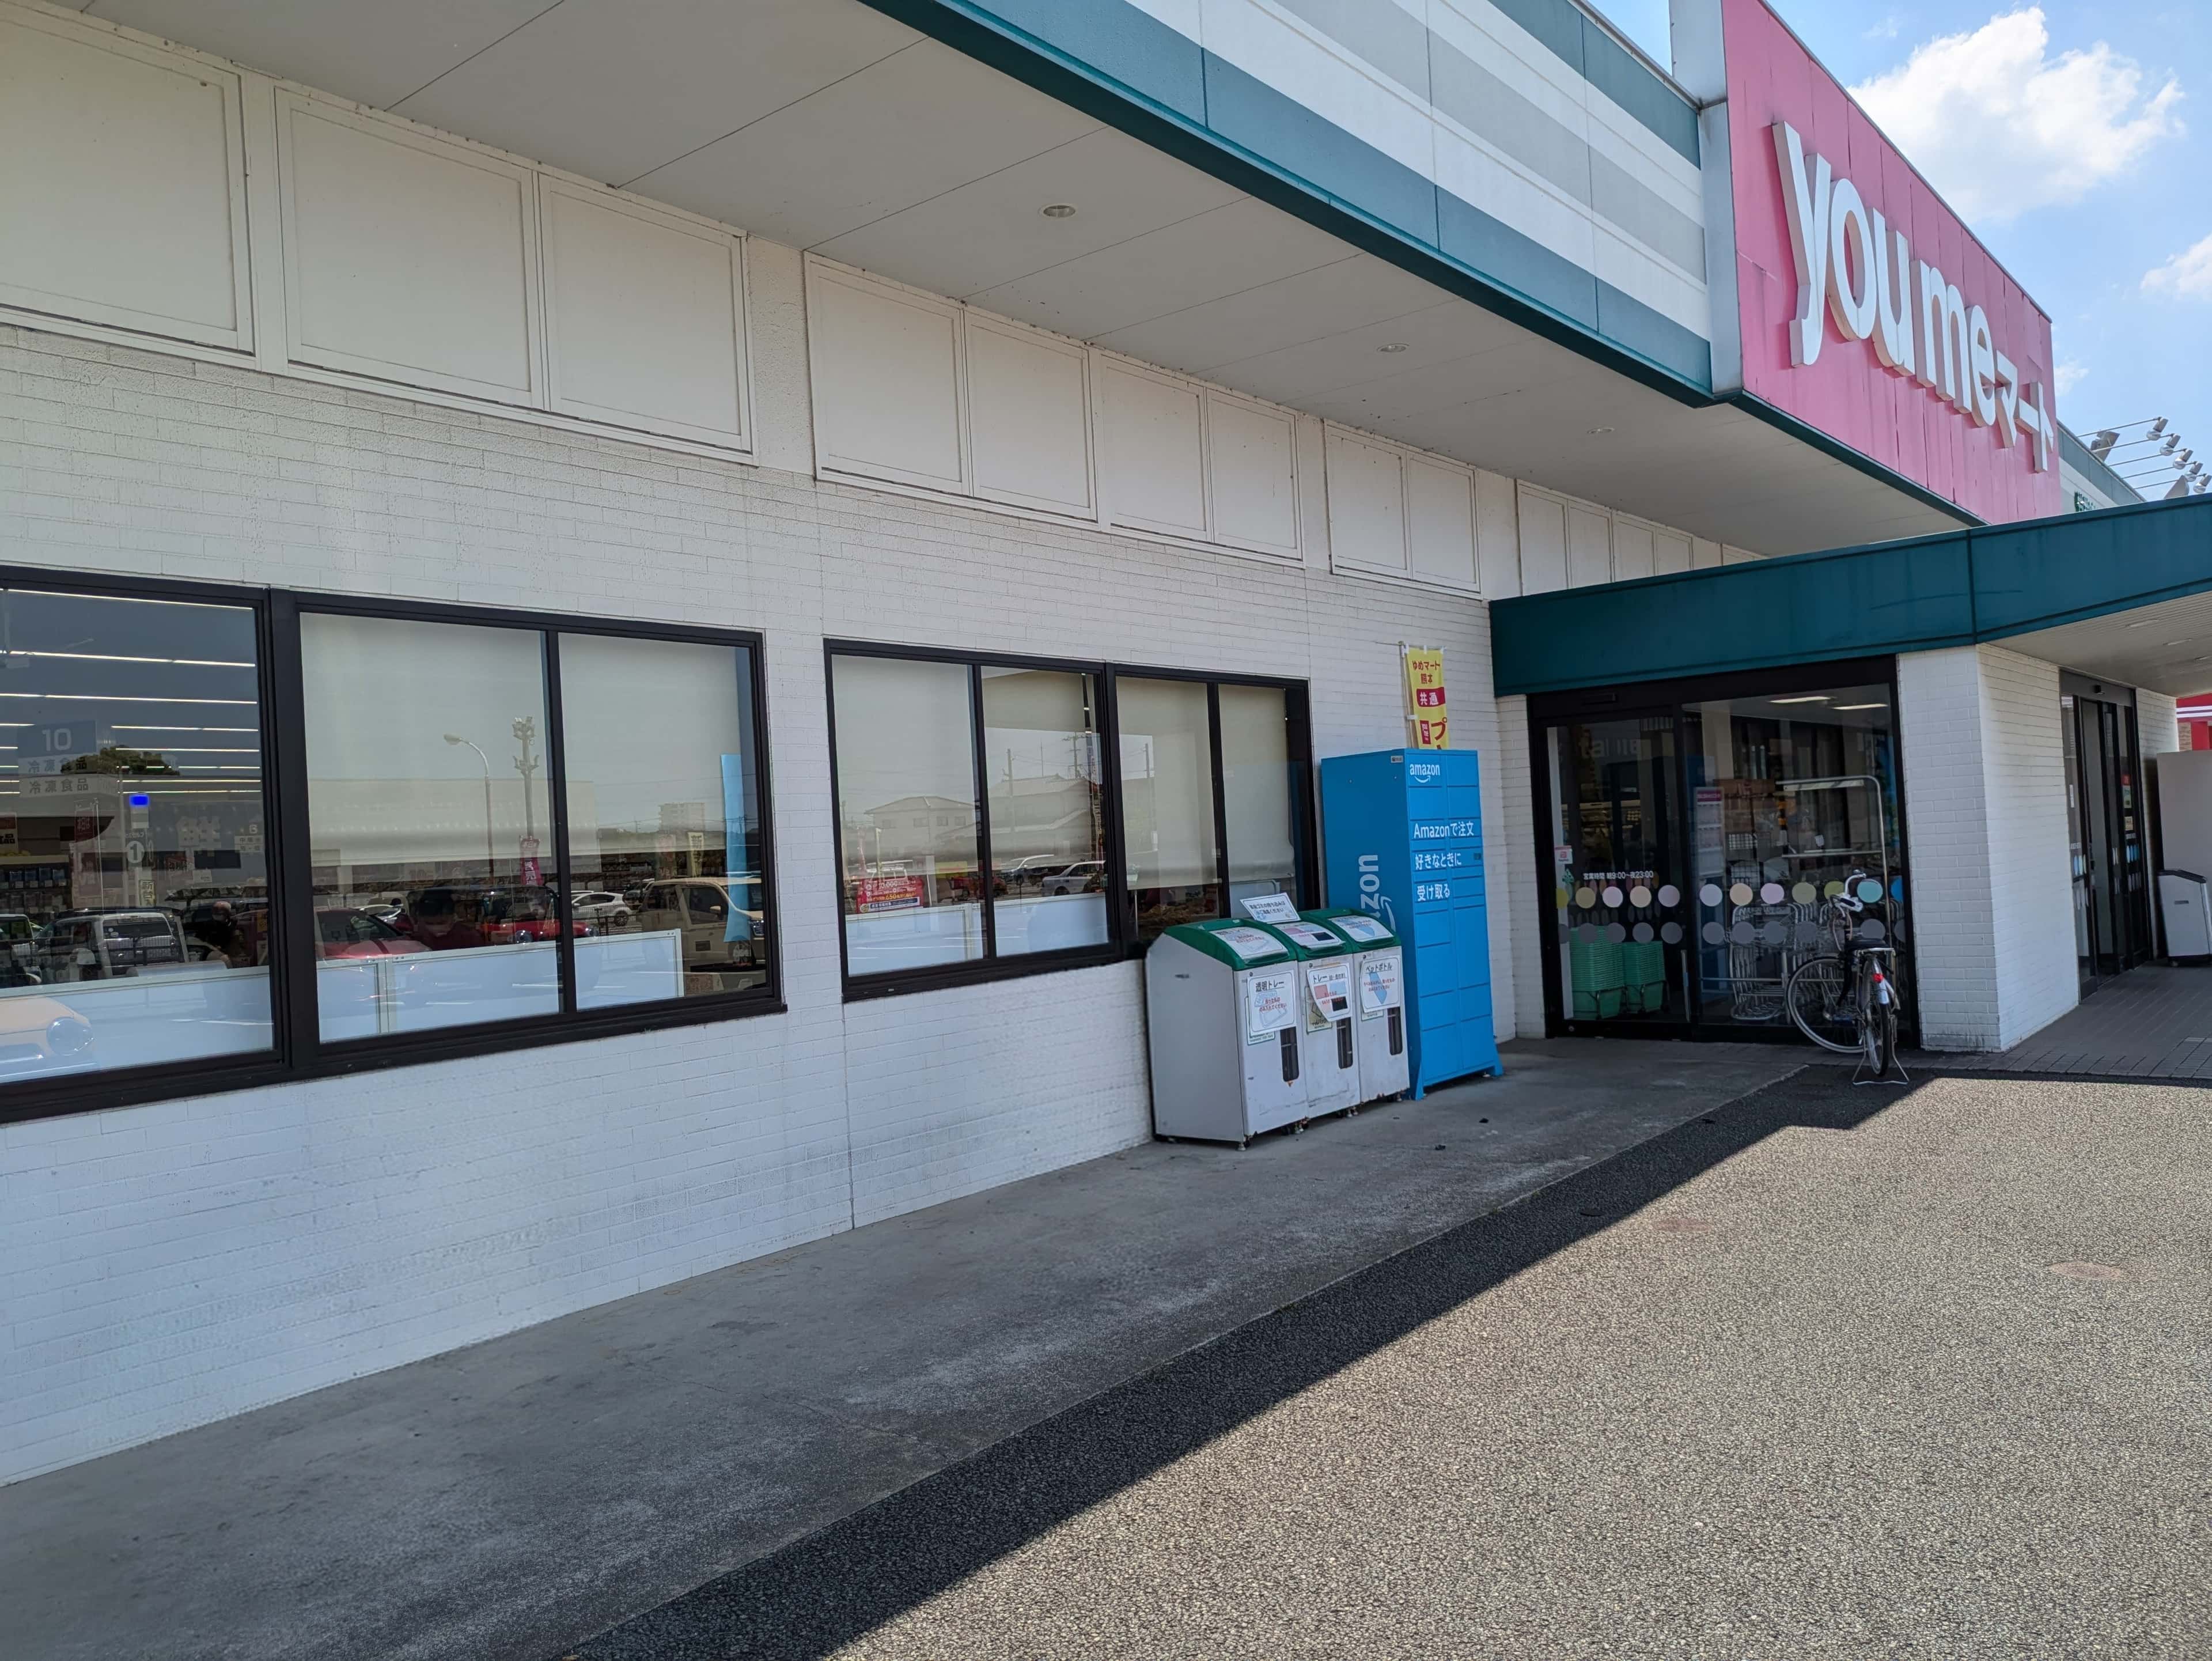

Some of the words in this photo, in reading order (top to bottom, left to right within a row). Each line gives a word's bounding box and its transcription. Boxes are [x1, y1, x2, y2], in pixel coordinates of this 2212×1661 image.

[1412, 660, 1440, 670] ゆめマート
[1421, 674, 1433, 684] 熊本
[1420, 692, 1438, 706] 共通
[1410, 764, 1440, 775] amazon
[29, 778, 88, 795] 冷凍食品
[1414, 821, 1474, 839] Amazonで注文
[1415, 853, 1461, 870] 好きなときに
[1358, 854, 1381, 919] zon
[1417, 884, 1450, 902] 受け取る
[1366, 963, 1392, 973] ペットボトル
[1313, 974, 1327, 983] トレー
[1256, 979, 1285, 992] 透明トレー
